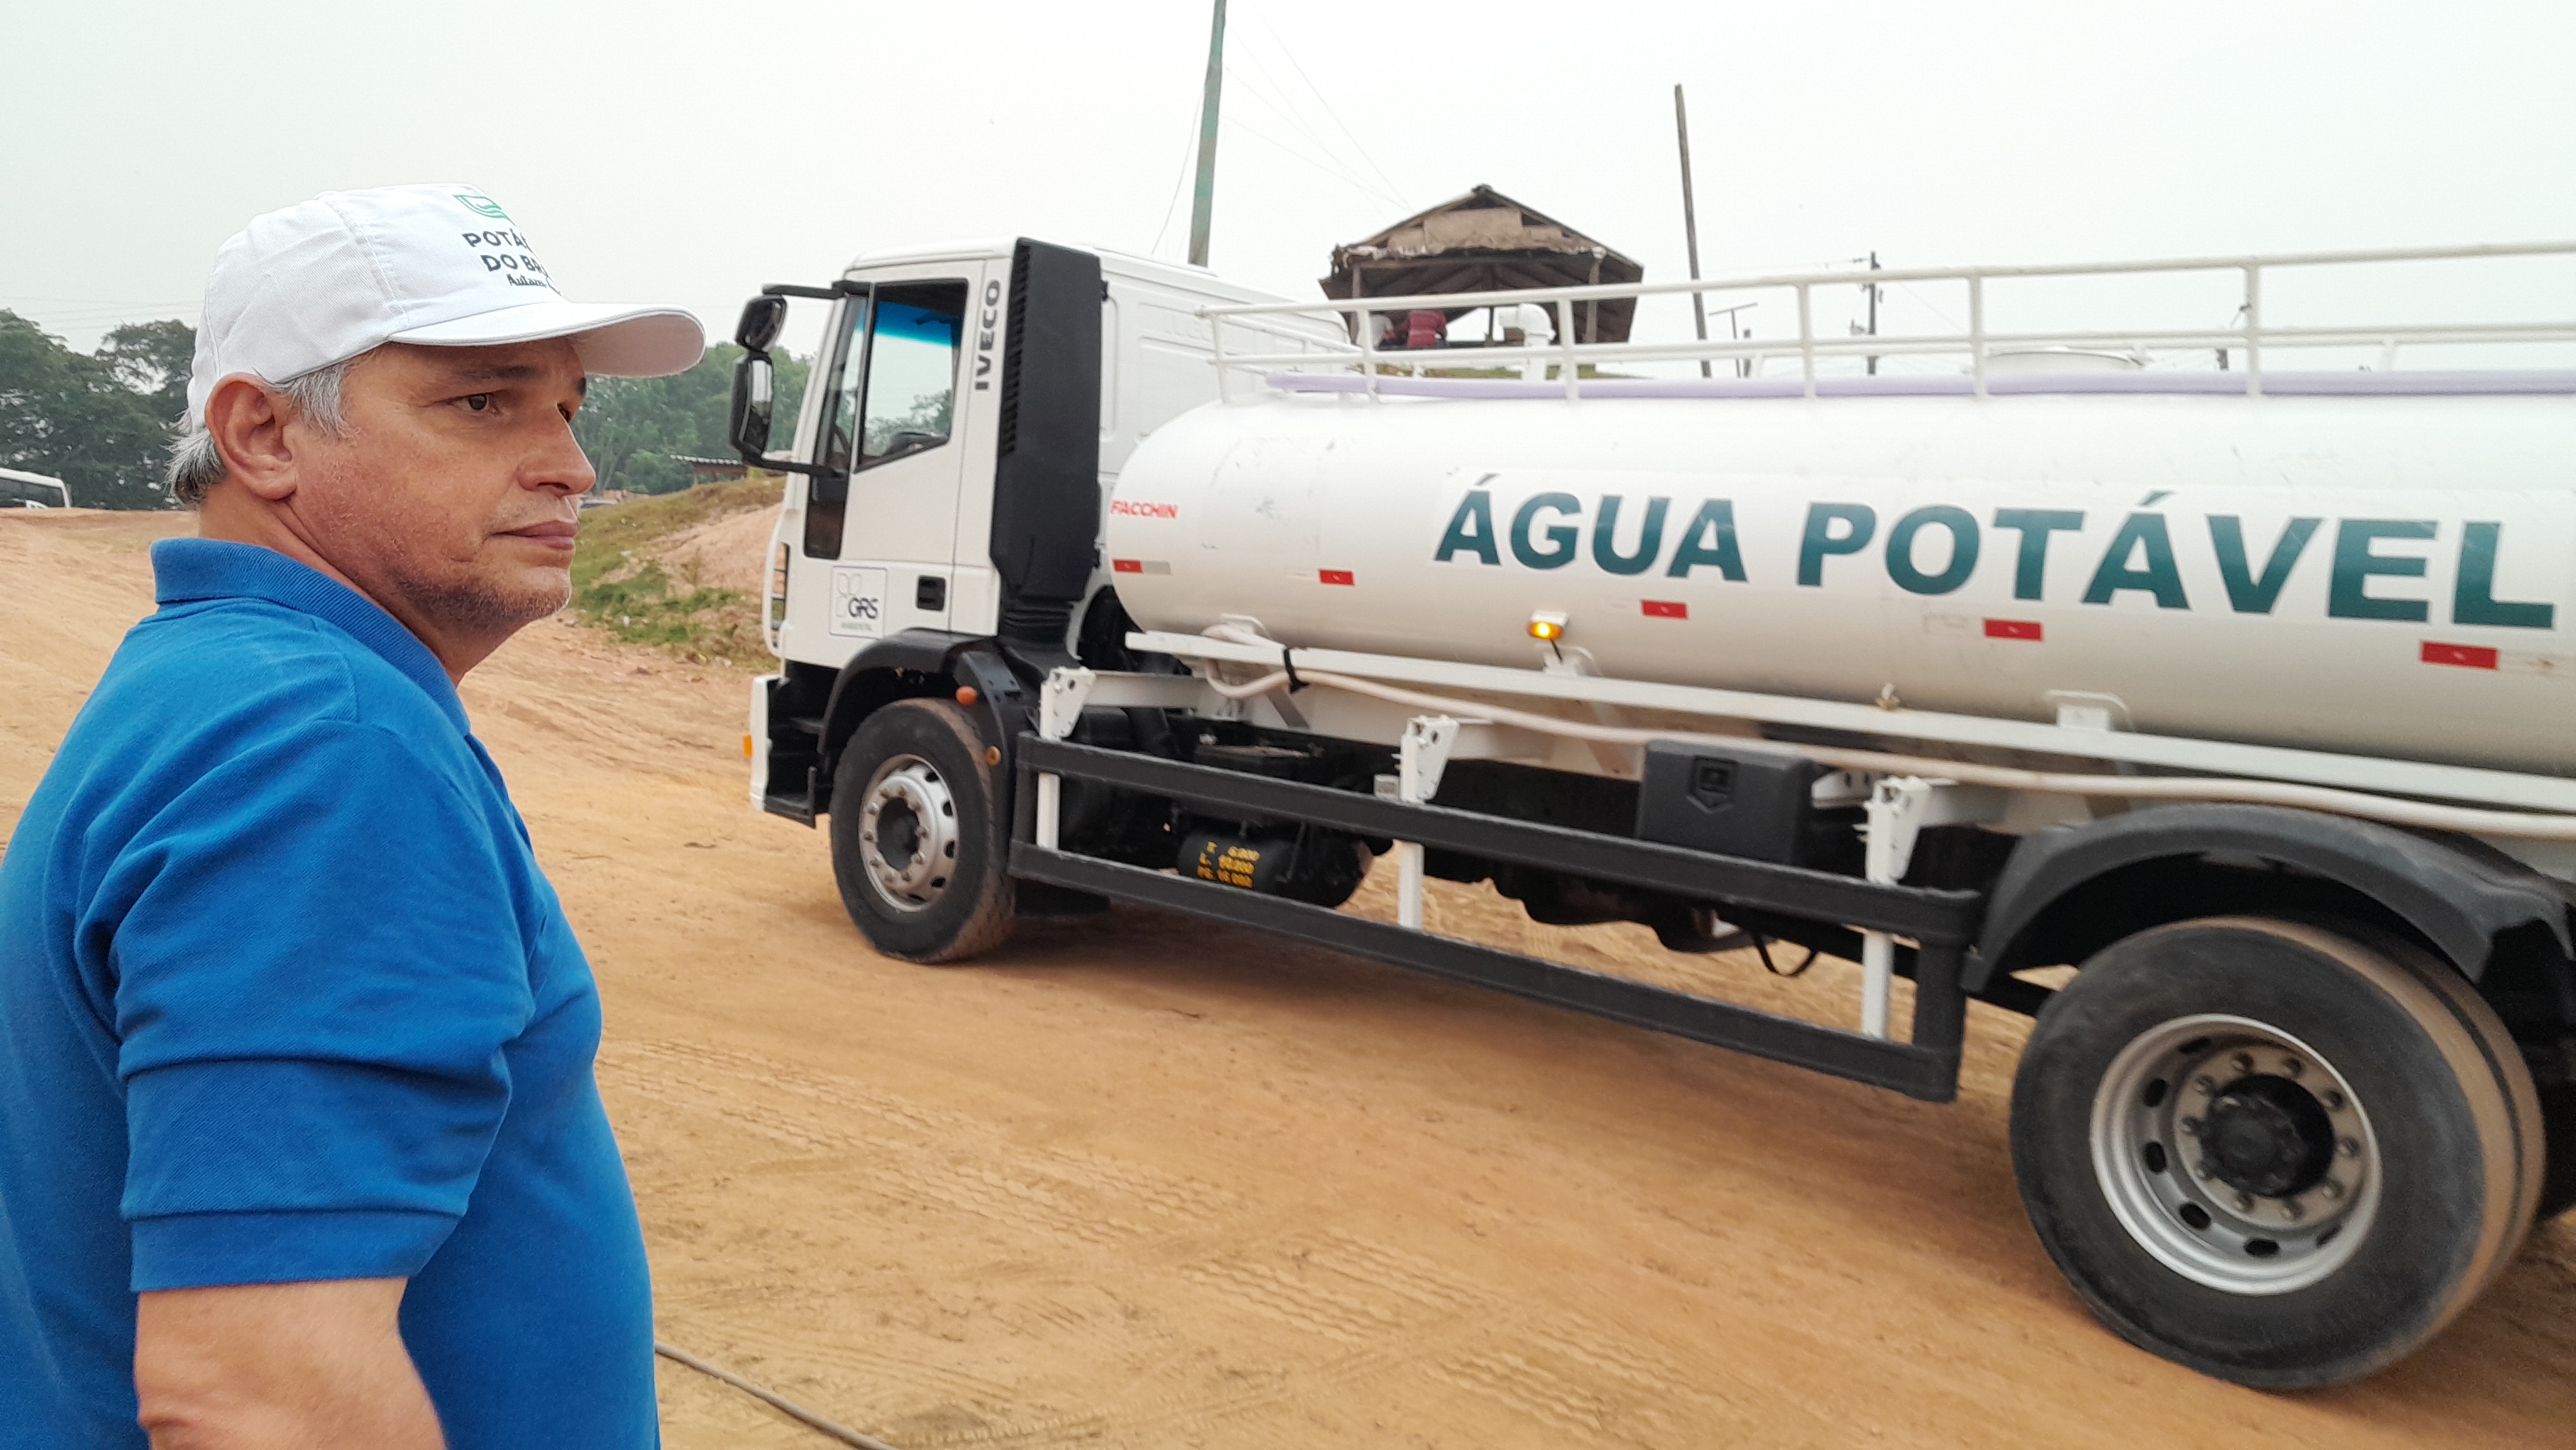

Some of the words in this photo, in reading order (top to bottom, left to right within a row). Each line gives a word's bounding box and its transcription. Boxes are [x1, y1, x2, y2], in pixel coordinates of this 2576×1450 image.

[480, 253, 518, 272] DO
[975, 279, 1000, 390] IVECO
[1434, 473, 1748, 583] ÁGUA
[1797, 490, 2555, 630] POTÁVEL
